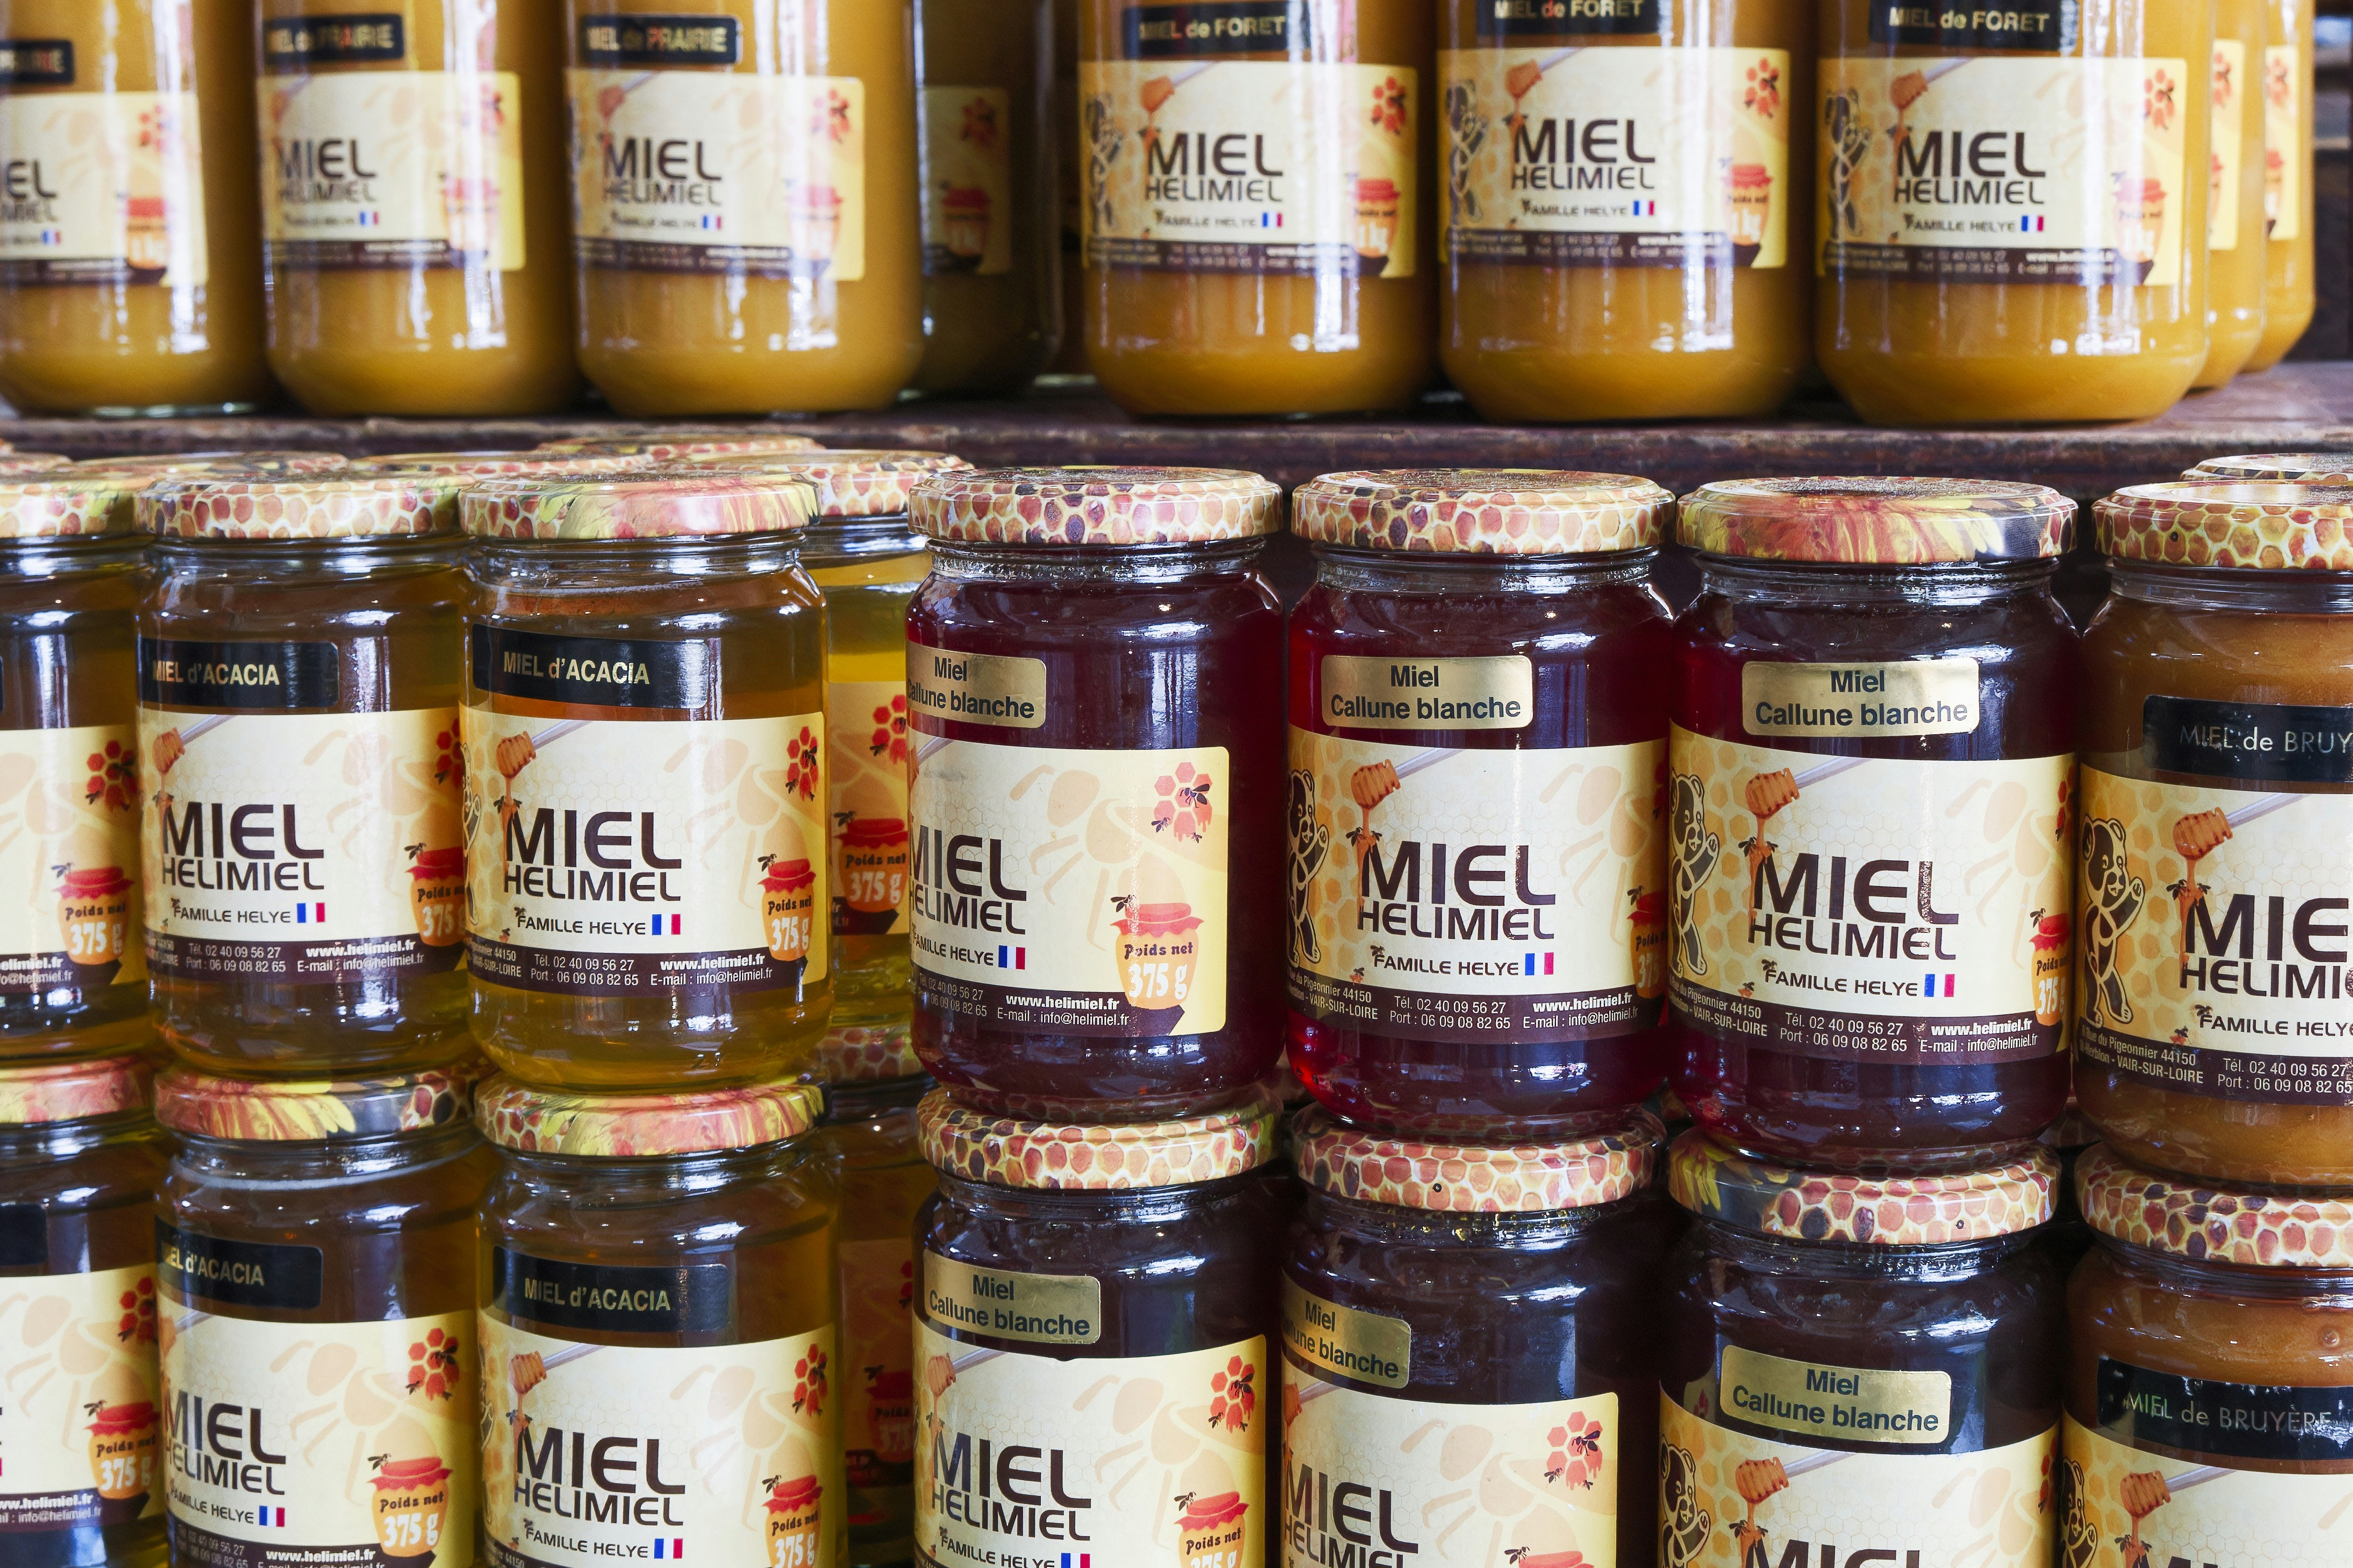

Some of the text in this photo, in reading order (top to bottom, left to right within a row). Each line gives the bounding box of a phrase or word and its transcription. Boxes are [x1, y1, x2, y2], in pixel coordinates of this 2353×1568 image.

[1495, 0, 1641, 18] MIEL de FORET
[1889, 7, 2050, 33] MIEL de FORET
[648, 25, 727, 53] PRAIRIE
[1186, 16, 1286, 38] de FORET
[1149, 132, 1283, 177] MIEL
[1514, 119, 1656, 164] MIEL
[1897, 131, 2046, 178] MIEL
[602, 140, 722, 181] MIEL
[1145, 178, 1283, 202] HELIMIEL
[1512, 166, 1654, 190] HELIMIEL
[1893, 179, 2045, 205] HELIMIEL
[189, 663, 280, 685] d'ACACIA
[504, 651, 650, 685] MIEL d'ACACIA
[935, 656, 967, 681] Miel
[1390, 665, 1439, 687] Miel
[1830, 670, 1885, 693] Miel
[951, 690, 1034, 719] blanche
[1331, 695, 1521, 720] Callune blanche
[1755, 701, 1968, 727] Callune blanche
[2180, 726, 2273, 751] MIEL de
[162, 801, 324, 860] MIEL
[506, 808, 682, 870] MIEL
[162, 858, 324, 891] HELIMIEL
[846, 853, 906, 869] Poids net
[911, 820, 1027, 901] MIEL
[1362, 841, 1556, 906] MIEL
[417, 886, 451, 903] Poids
[504, 867, 682, 902] HELIMIEL
[850, 870, 902, 904] 375 g
[1754, 854, 1959, 925] MIEL
[65, 905, 103, 921] Poids
[173, 904, 291, 924] FAMILLE HELYE
[768, 895, 812, 916] Poids net
[422, 903, 455, 938] 375
[517, 913, 646, 936] FAMILLE HELYE
[771, 916, 809, 952] 375 g
[1358, 900, 1555, 941] HELIMIEL
[71, 921, 107, 956] 375
[306, 939, 416, 958] www.helimiel.fr
[1124, 942, 1193, 960] Poids net
[1748, 914, 1957, 961] HELIMIEL
[297, 960, 333, 973] E-mail
[660, 952, 765, 971] www.helimiel.fr
[950, 945, 993, 966] HELYE
[1374, 954, 1519, 976] FAMILLE HELYE
[2036, 958, 2058, 976] Poids
[650, 967, 773, 986] E-mail info@helimiel.fr
[1128, 962, 1188, 1000] 375 g
[1303, 975, 1341, 997] Pigeonnier
[1343, 987, 1372, 1003] 44150
[1765, 969, 1918, 997] FAMILLE HELYE
[1006, 994, 1120, 1011] www.helimiel.fr
[1309, 993, 1378, 1020] VAIR-SUR-LOIRE
[1533, 992, 1632, 1013] www.helimiel.fr
[1687, 986, 1728, 1011] Pigeonnier
[1730, 1002, 1761, 1019] 44150
[2038, 977, 2059, 1015] 375
[997, 1007, 1130, 1026] E-mail info@helimiel.fr
[1522, 1006, 1638, 1029] E-mail info@helimiel.fr
[1693, 1005, 1768, 1037] VAIR-SUR-LOIRE
[1785, 1012, 1903, 1035] Tél. 02 40 09 56 27
[1931, 1018, 2032, 1036] www.helimiel.fr
[2199, 1014, 2288, 1035] FAMILLE
[1780, 1027, 1907, 1051] Port 06 09 08 82 65
[1920, 1033, 2038, 1052] E-mail info@helimiel.fr
[2098, 1033, 2107, 1046] du
[2109, 1036, 2158, 1059] Pigeonnier
[2161, 1049, 2196, 1066] 44150
[2117, 1054, 2204, 1084] VAIR-SUR-LOIRE
[2222, 1057, 2347, 1077] Tél. 02 40 09 56 27
[2218, 1073, 2353, 1093] Port 06 09 08 82 65
[185, 1252, 265, 1287] d'ACACIA
[525, 1278, 671, 1313] MIEL d'ACACIA
[973, 1274, 1014, 1301] Miel
[929, 1289, 1090, 1337] Callune blanche
[1305, 1300, 1335, 1332] Miel
[1319, 1337, 1399, 1379] blanche
[1806, 1369, 1859, 1396] Miel
[1733, 1384, 1939, 1431] Callune blanche
[2125, 1391, 2210, 1427] MIEL de
[165, 1389, 287, 1464] MIEL
[96, 1440, 134, 1458] Poids
[516, 1426, 686, 1495] MIEL
[100, 1455, 137, 1491] 375
[934, 1431, 1092, 1509] MIEL
[212, 1503, 254, 1525] HELYE
[380, 1491, 444, 1513] Poids net
[514, 1481, 684, 1527] HELIMIEL
[932, 1484, 1090, 1542] HELIMIEL
[1285, 1461, 1419, 1554] MIEL
[383, 1512, 439, 1548] 375 g
[772, 1517, 802, 1536] Poids
[526, 1527, 648, 1558] FAMILLE HELYE
[775, 1531, 815, 1568] 375 g
[941, 1535, 1055, 1568] FAMILLE HELYE
[1186, 1527, 1241, 1555] Poids net
[266, 1548, 376, 1563] www.helimiel.fr
